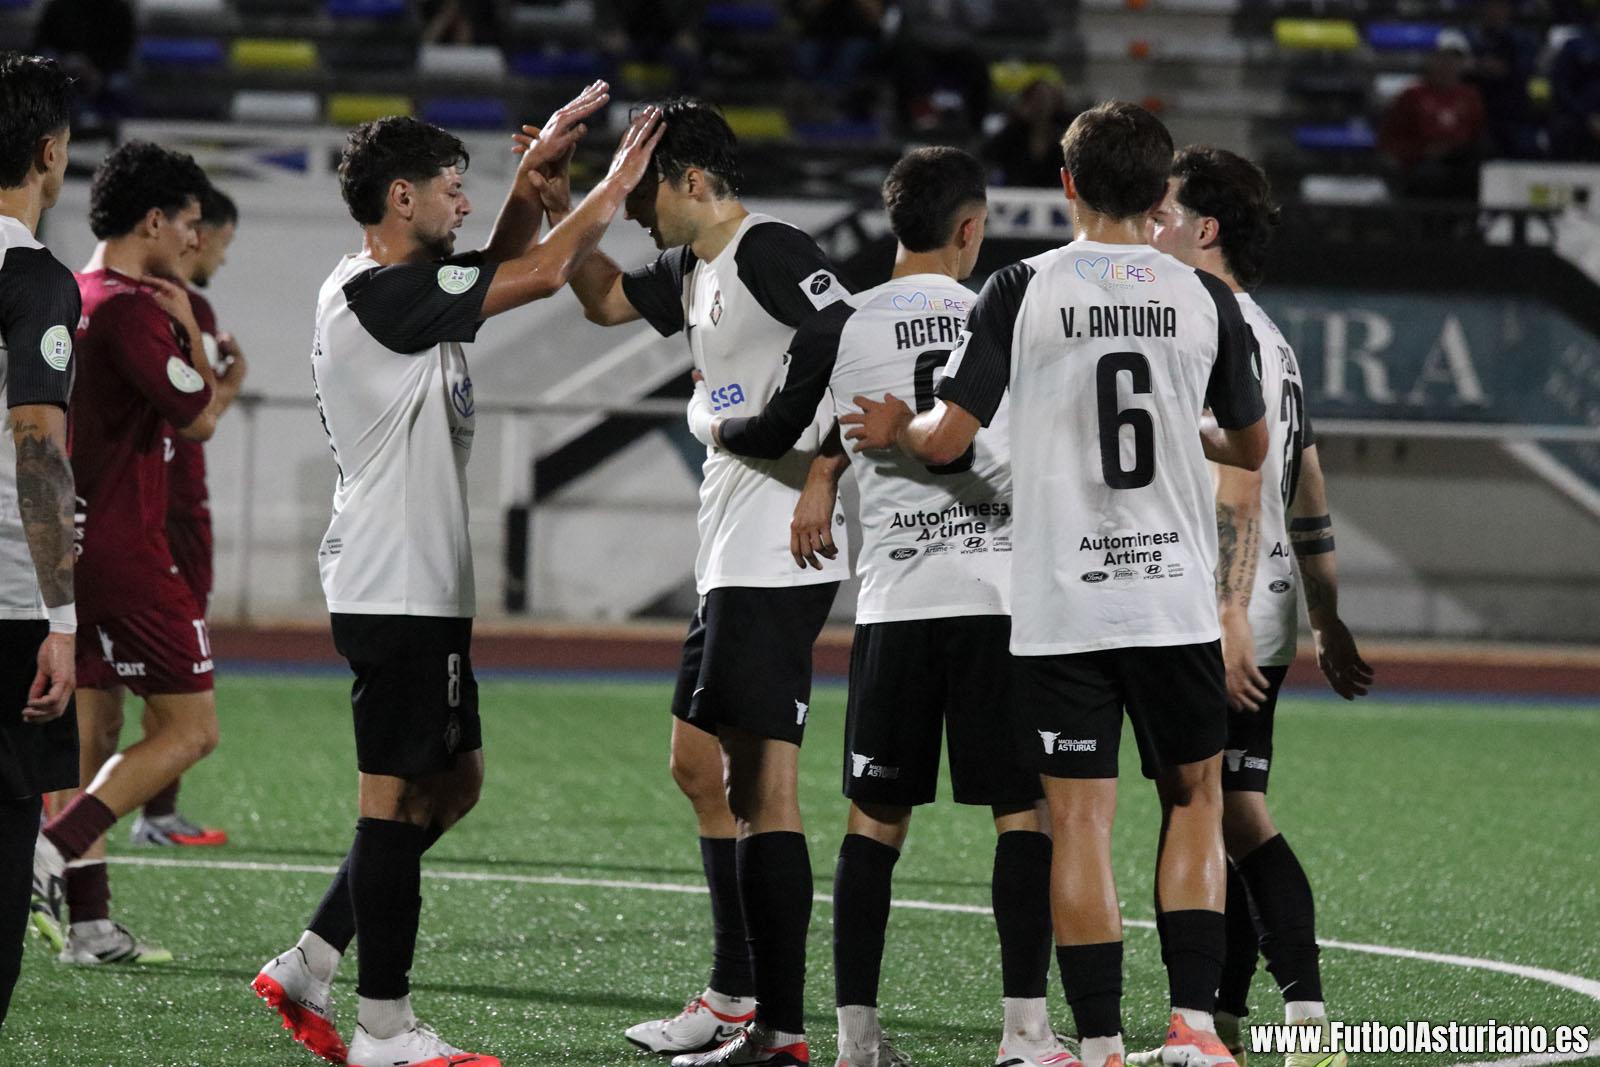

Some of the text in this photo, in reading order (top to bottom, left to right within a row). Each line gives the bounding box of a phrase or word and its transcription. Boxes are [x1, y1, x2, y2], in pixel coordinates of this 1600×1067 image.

[895, 316, 966, 350] ACERE
[1060, 300, 1176, 338] V. ANTUÑA
[1284, 306, 1490, 407] RA
[1096, 352, 1156, 490] 6
[890, 502, 1011, 529] Autominesa
[916, 521, 986, 541] Artime
[1079, 531, 1180, 551] Autominesa
[1104, 550, 1162, 566] Artime
[448, 653, 460, 707] 8
